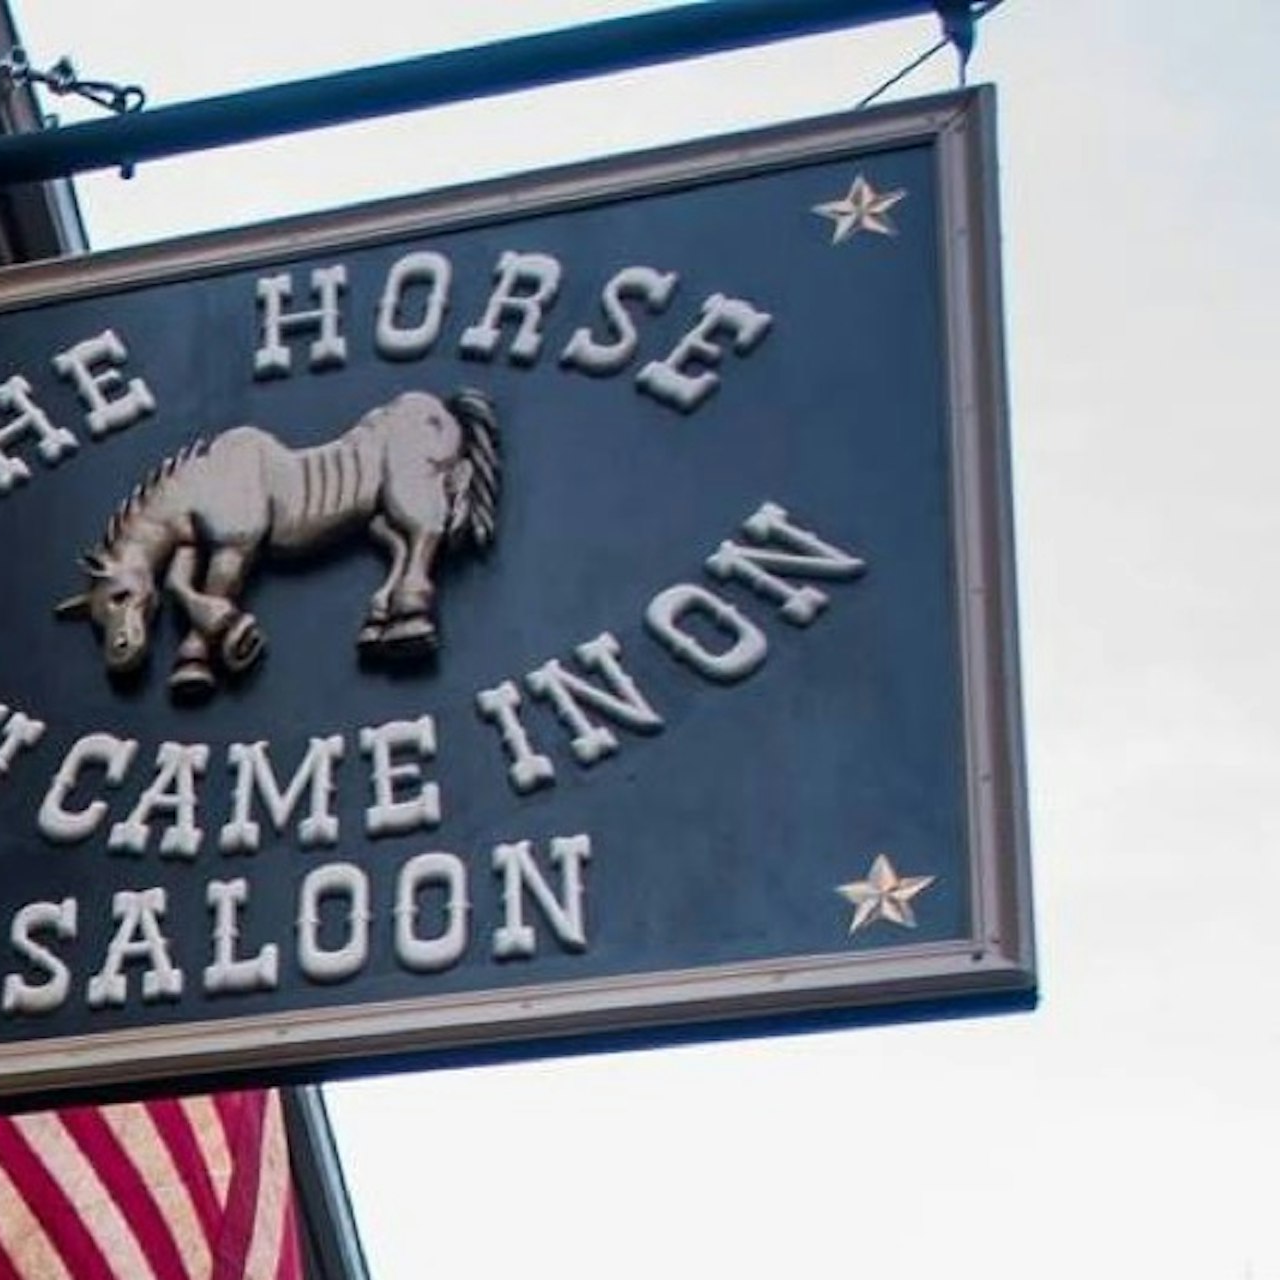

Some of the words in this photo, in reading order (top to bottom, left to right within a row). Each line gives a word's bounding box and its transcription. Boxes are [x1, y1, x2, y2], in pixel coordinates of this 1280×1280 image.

[251, 249, 773, 414] HORSE
[35, 715, 443, 861] CAME
[474, 629, 666, 795] IN
[644, 498, 867, 683] ON
[0, 833, 593, 1015] SALOON
